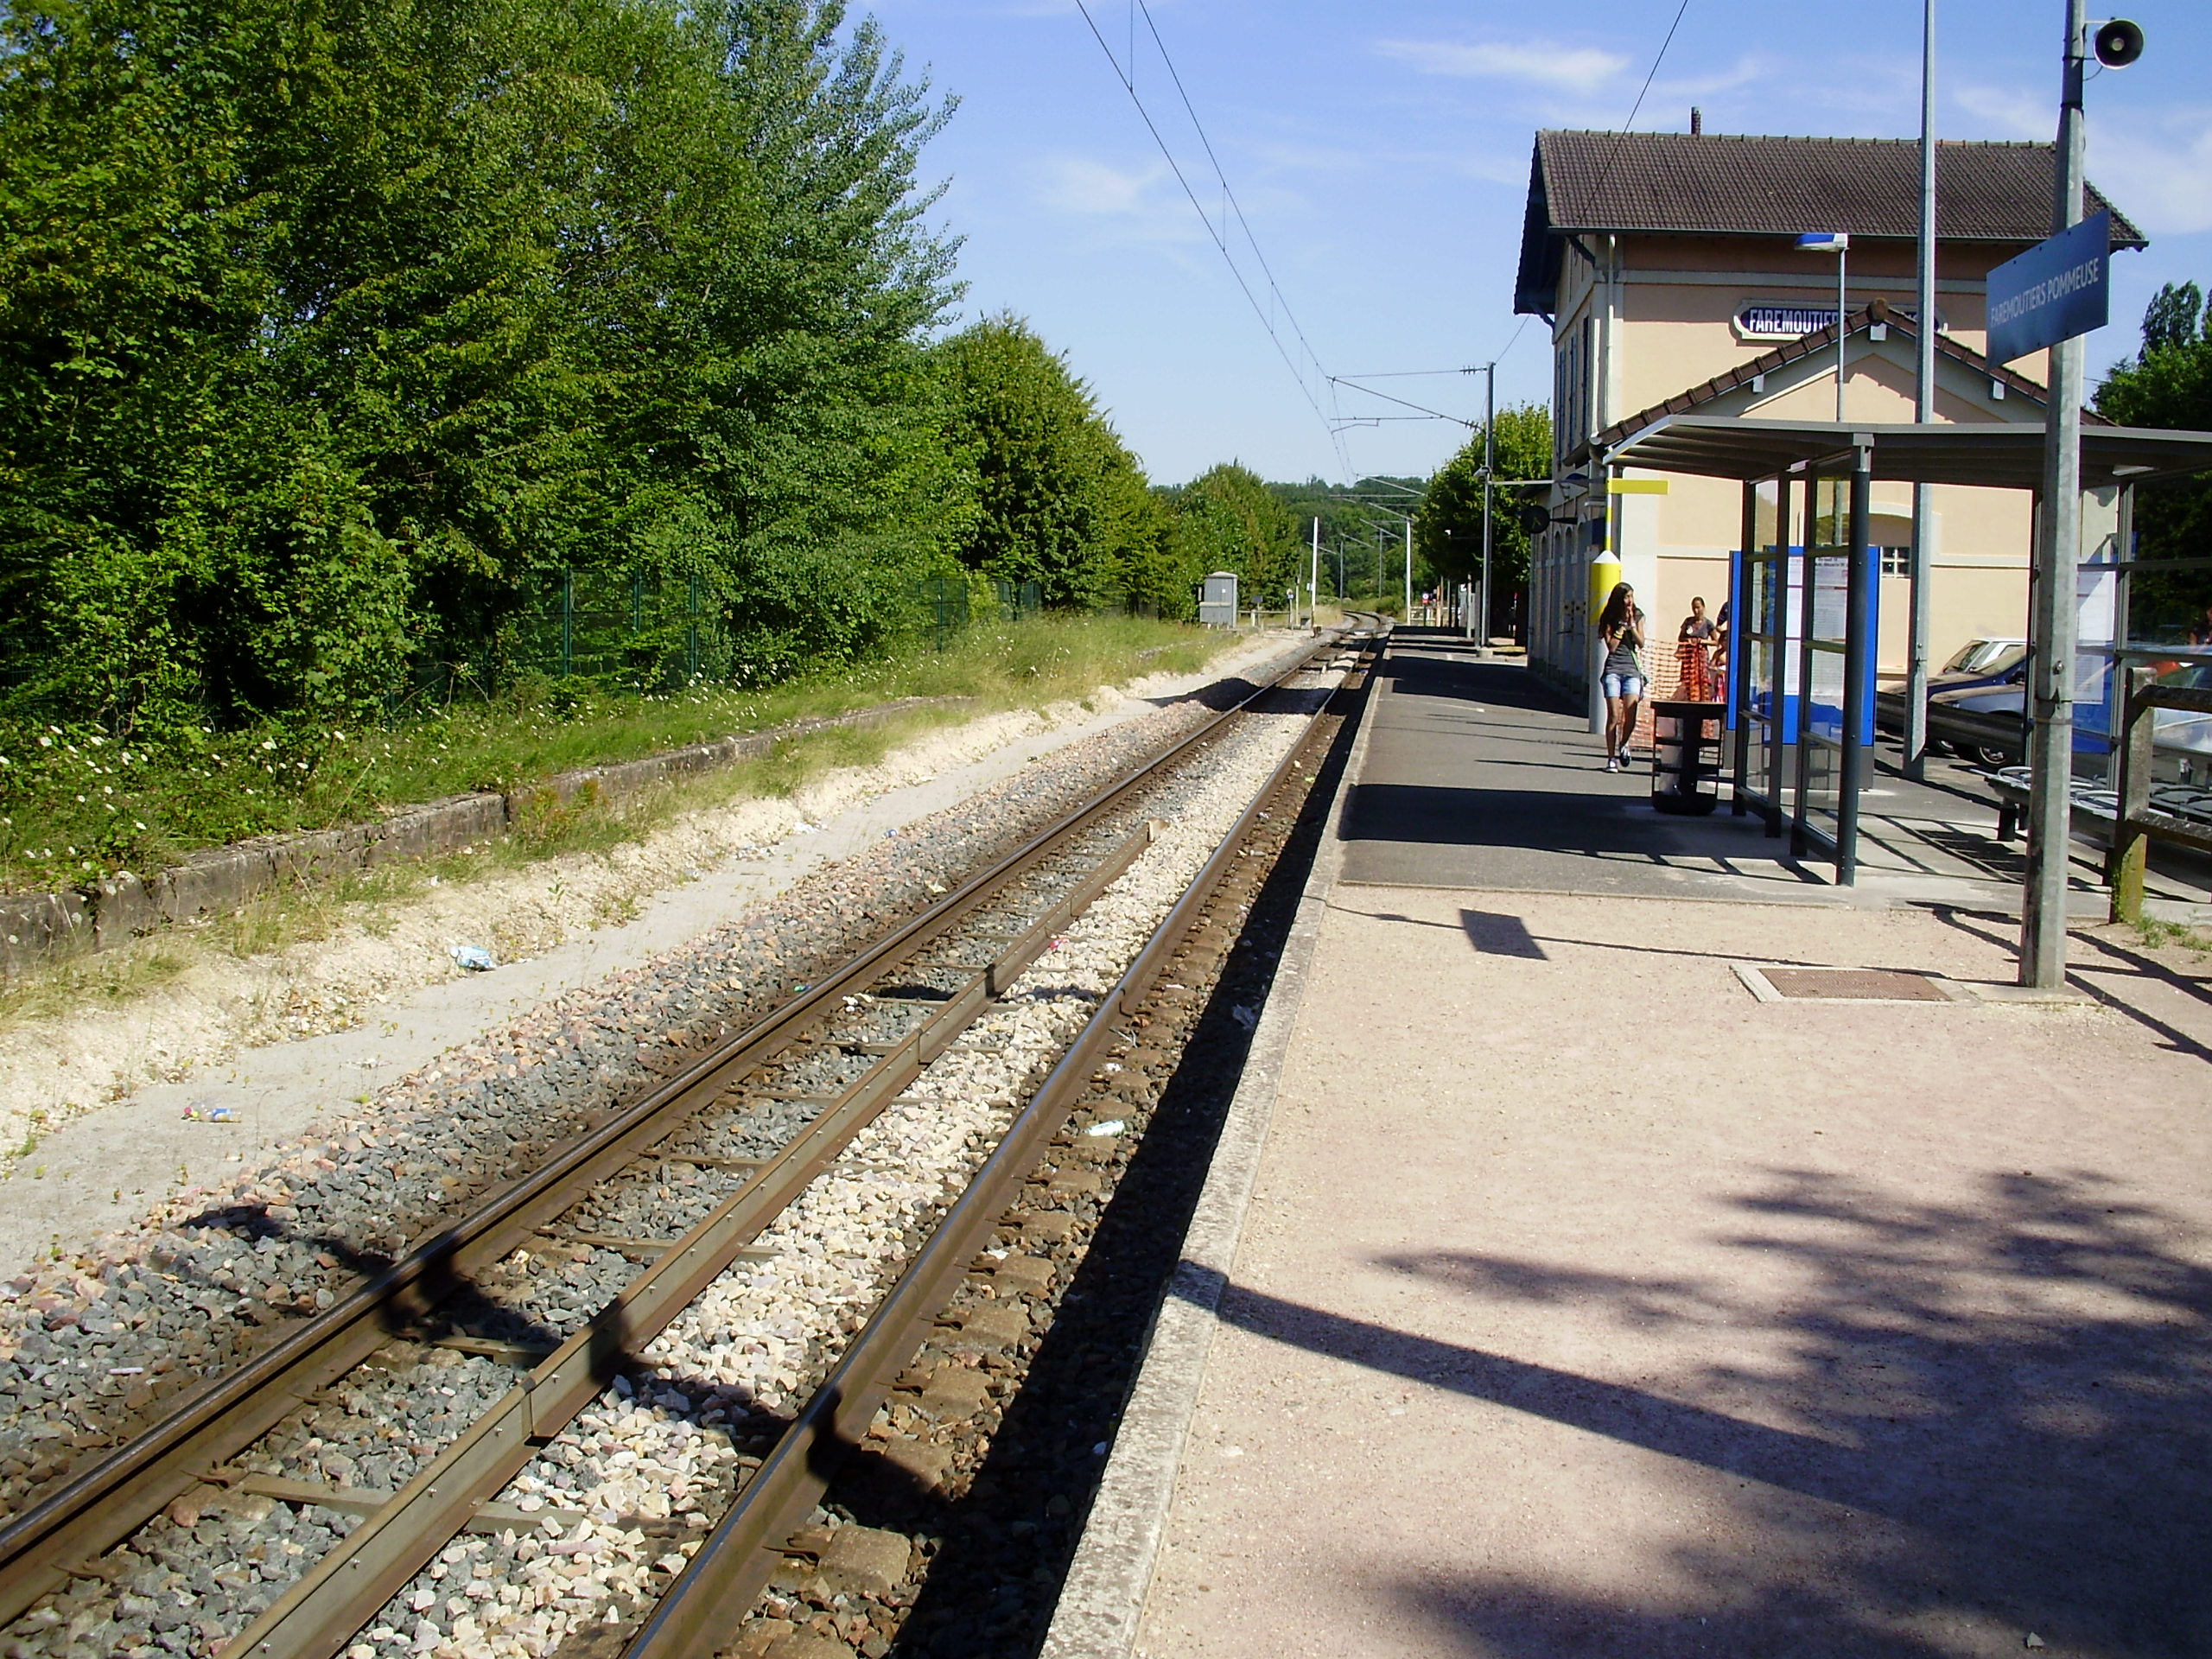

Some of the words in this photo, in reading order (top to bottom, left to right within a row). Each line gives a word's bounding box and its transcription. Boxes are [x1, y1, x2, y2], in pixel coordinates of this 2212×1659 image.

[1990, 282, 2046, 327] FAREMOUTIERS
[2047, 257, 2099, 302] POMMEUSE
[1749, 308, 1848, 334] FAREMOUTIER
